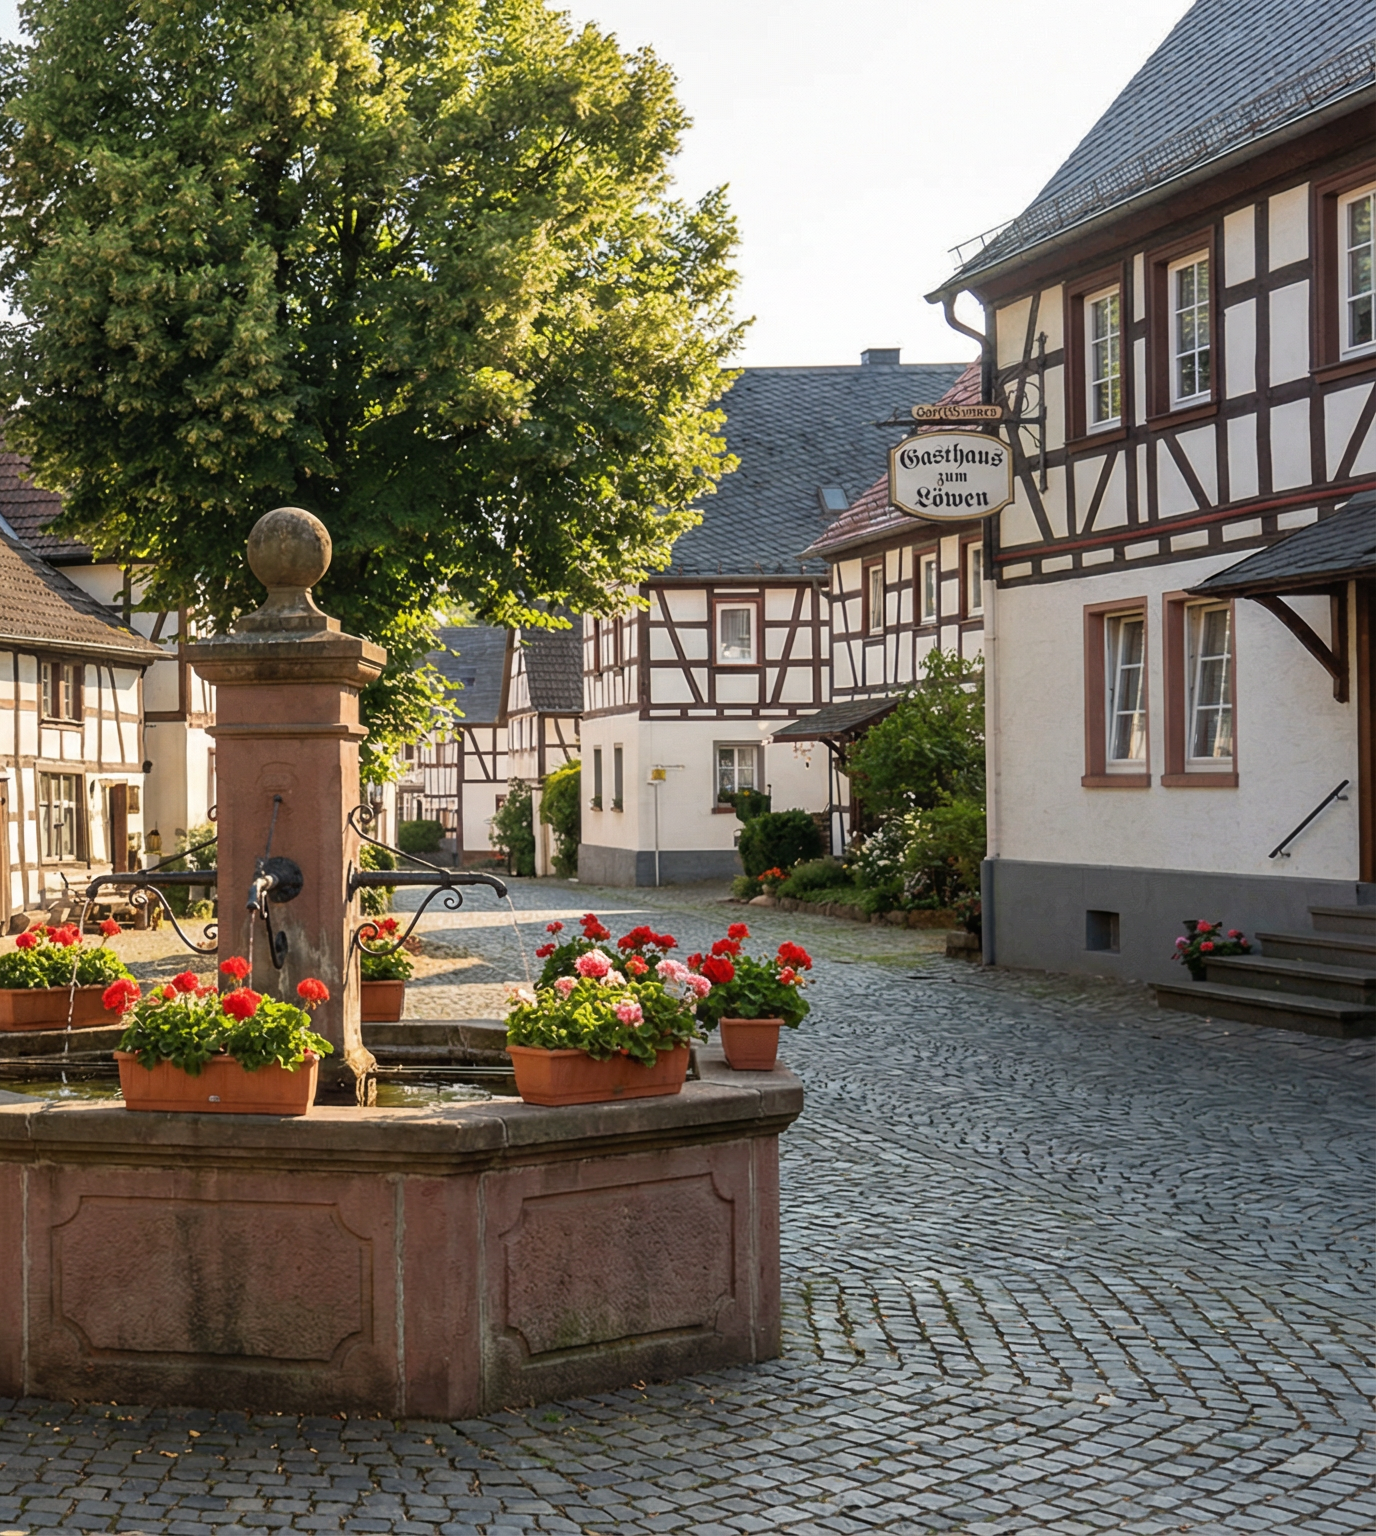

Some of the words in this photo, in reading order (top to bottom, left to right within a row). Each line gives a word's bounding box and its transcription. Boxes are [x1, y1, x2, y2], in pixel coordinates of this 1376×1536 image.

[900, 443, 1003, 469] Gasthaus
[937, 472, 967, 487] zum
[915, 487, 989, 507] Löwen
